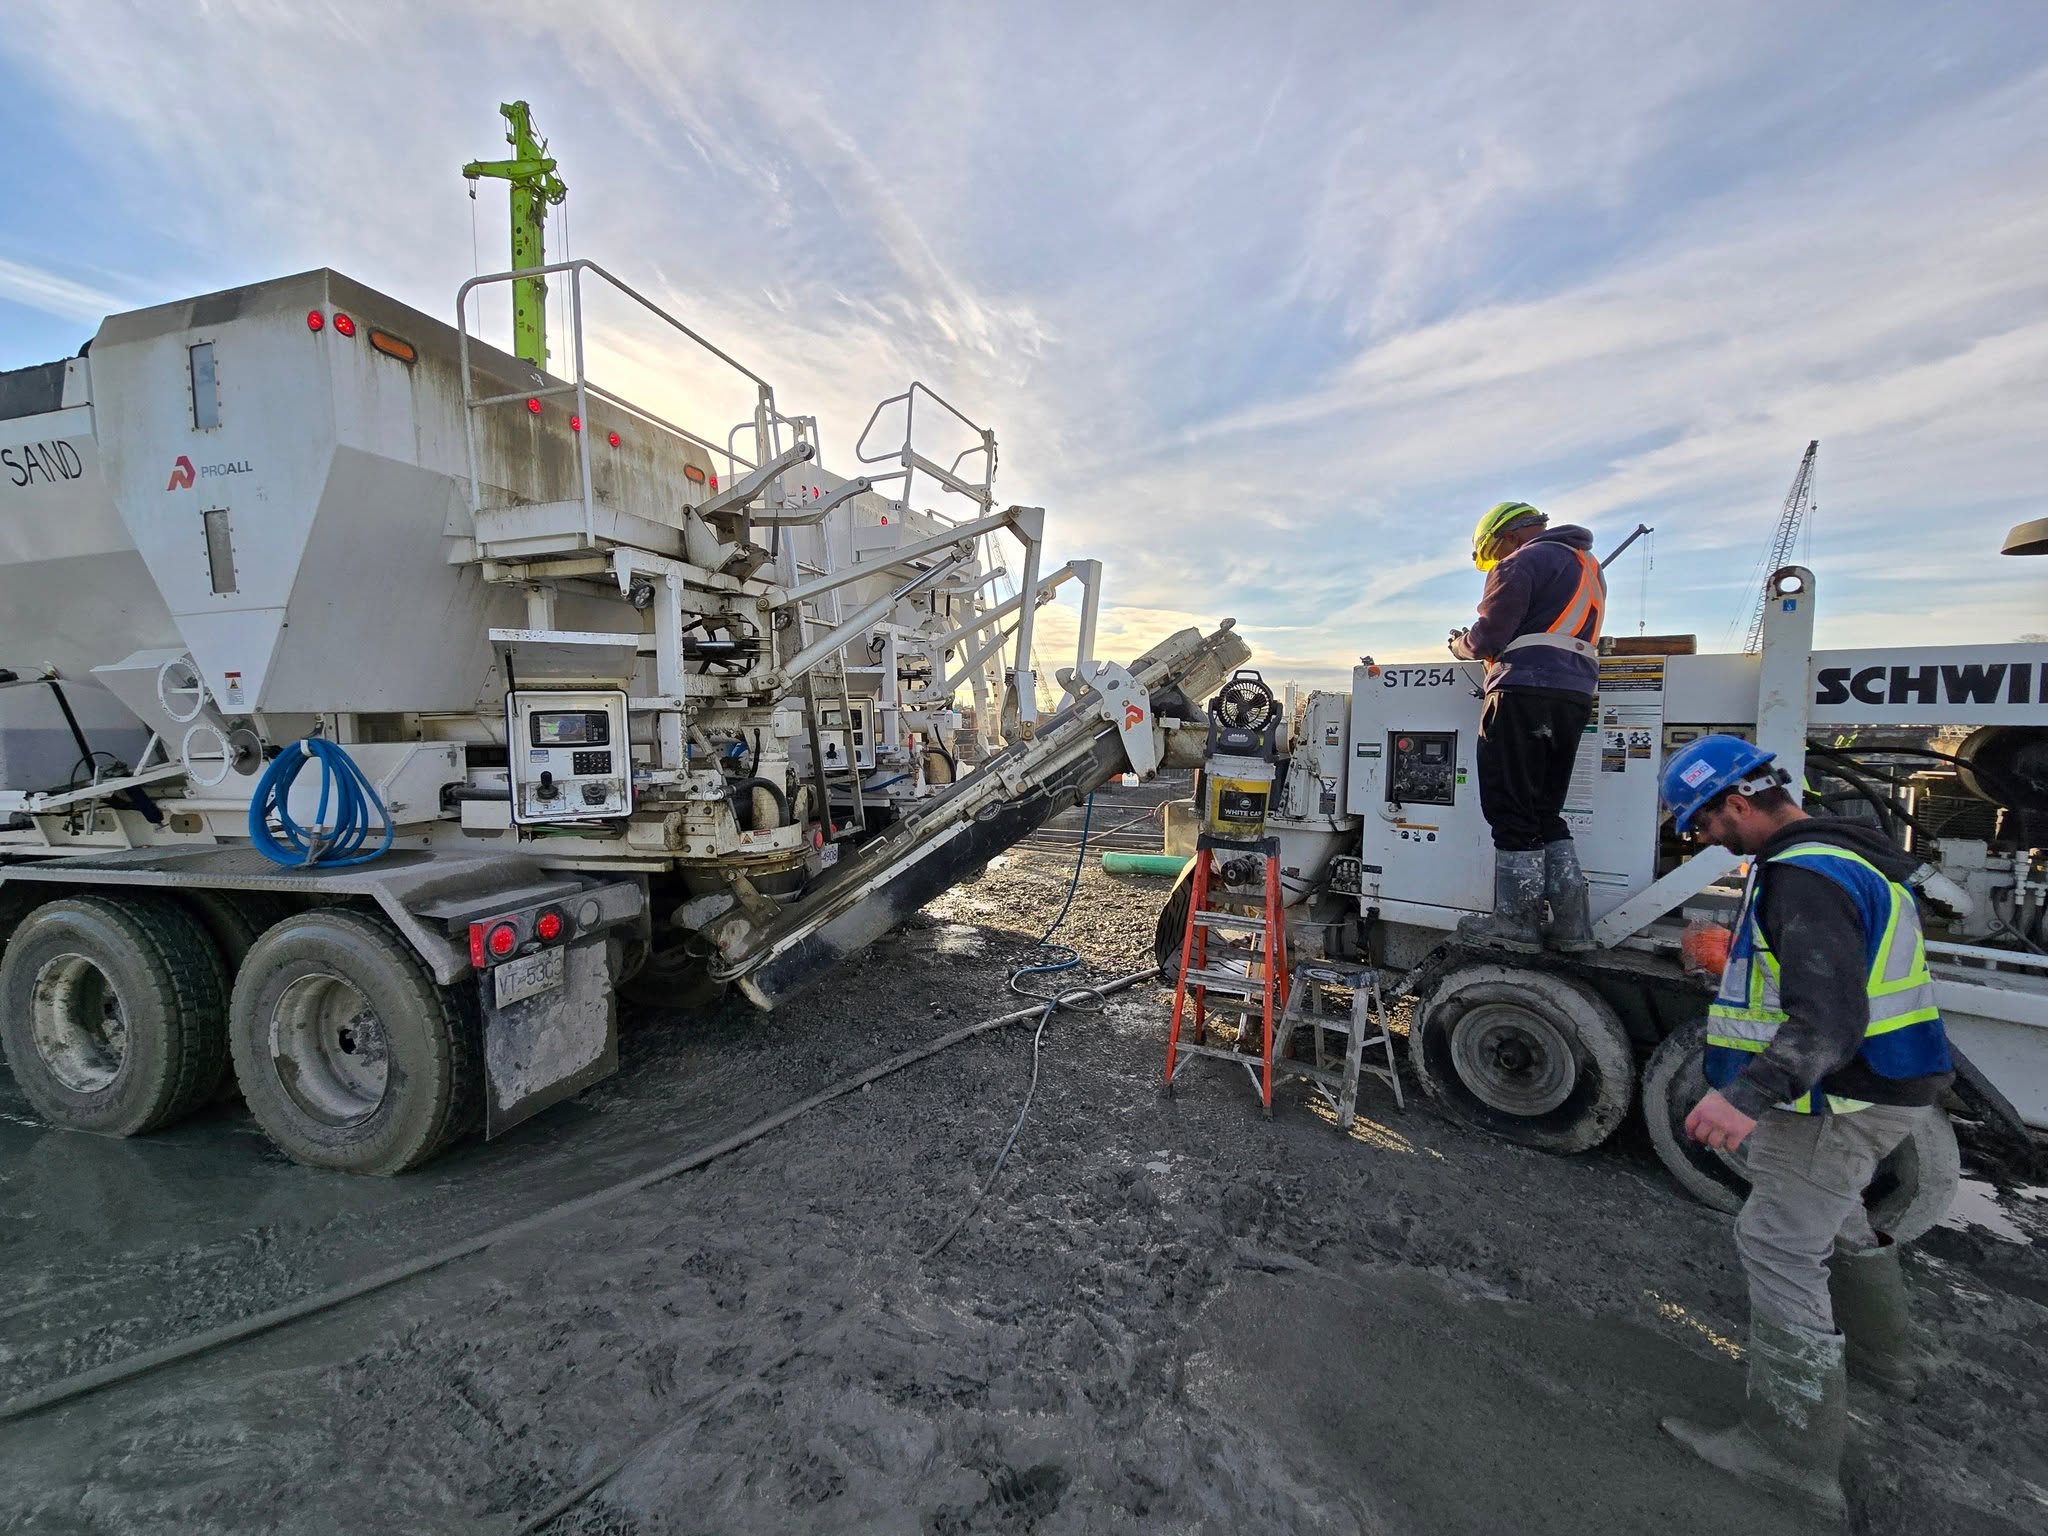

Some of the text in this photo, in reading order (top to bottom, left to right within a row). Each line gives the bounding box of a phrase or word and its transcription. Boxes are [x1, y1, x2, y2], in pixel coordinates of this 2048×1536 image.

[1, 440, 82, 487] SAND
[201, 461, 253, 478] PROALL
[1383, 668, 1455, 688] ST254
[1816, 662, 2048, 704] SCHWI
[1224, 808, 1249, 817] WHITE
